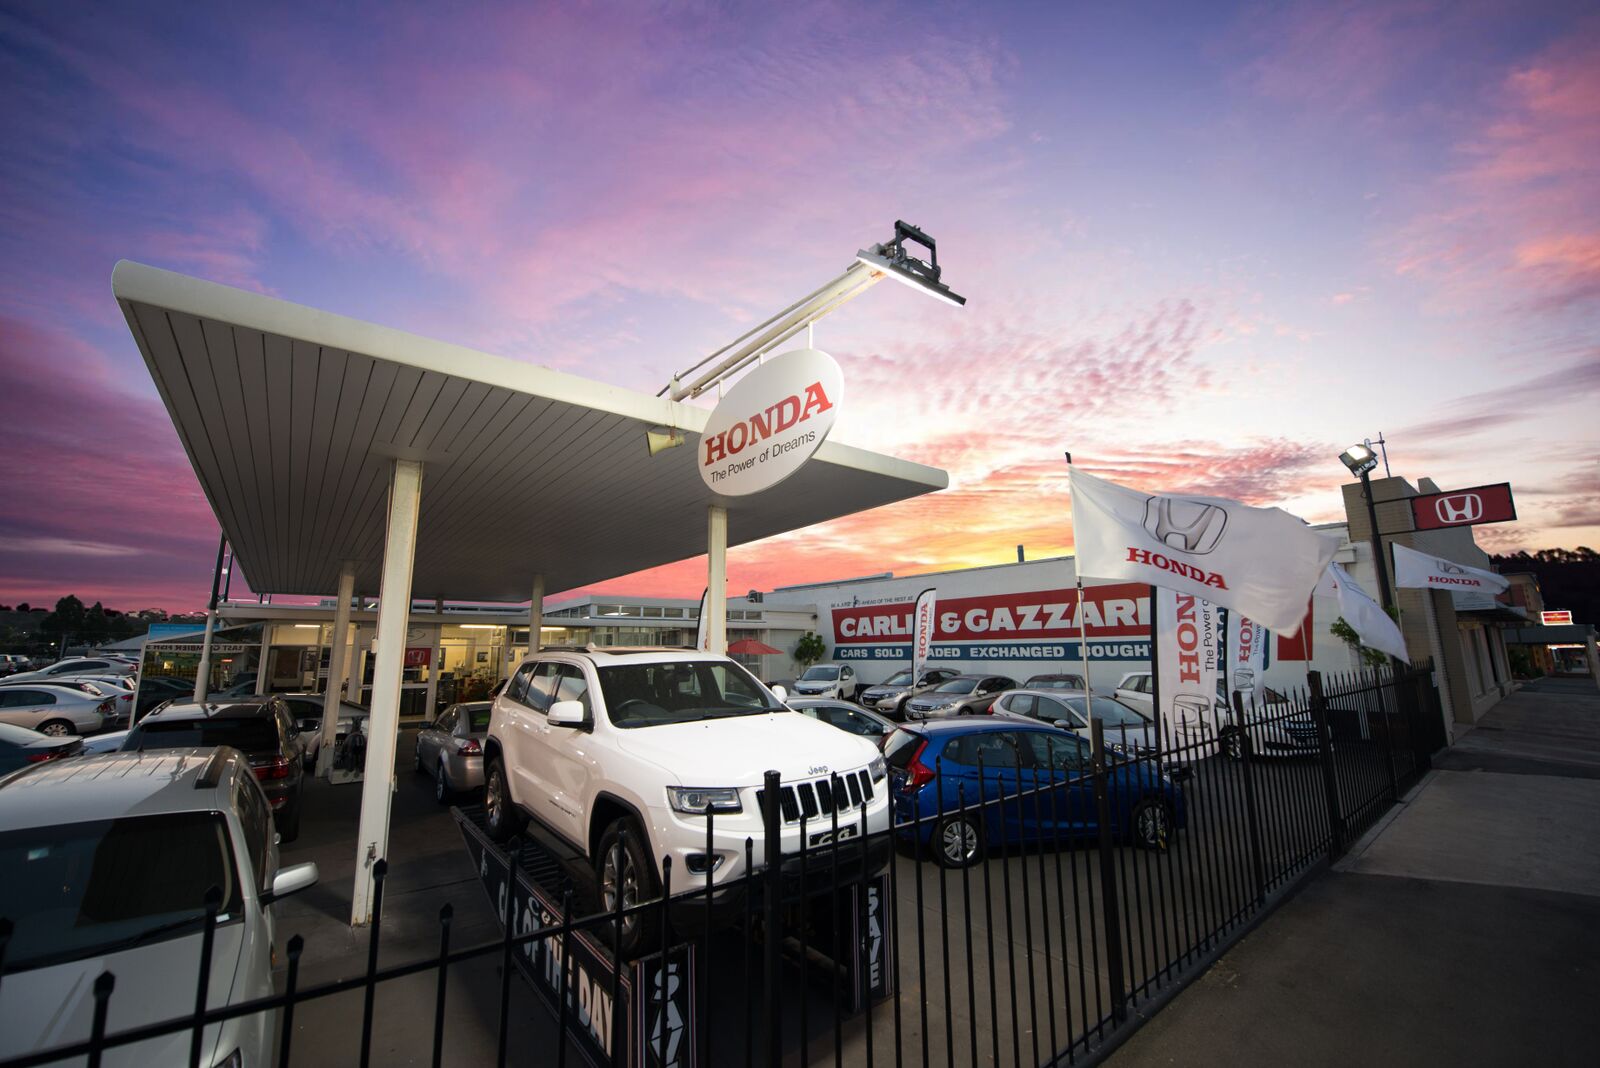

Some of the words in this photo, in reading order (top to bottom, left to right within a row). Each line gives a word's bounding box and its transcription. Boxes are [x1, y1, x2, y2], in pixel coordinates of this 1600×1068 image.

[705, 382, 833, 466] HONDA
[710, 469, 727, 483] The
[728, 456, 757, 476] Power
[759, 448, 770, 463] of
[772, 430, 816, 457] Dreams
[1126, 547, 1229, 590] HONDA
[1428, 576, 1481, 587] HONDA
[840, 613, 935, 637] CARLI
[940, 612, 962, 633] &
[918, 603, 929, 658] HONDA
[1176, 592, 1200, 684] HON
[1203, 609, 1213, 647] Power
[1239, 616, 1253, 662] HON
[840, 648, 868, 658] CARS
[875, 648, 904, 657] SOLD
[927, 647, 961, 657] ADED
[970, 646, 1065, 658] EXCHANGED
[1077, 644, 1152, 657] BOUGH
[1205, 651, 1215, 673] The
[808, 765, 829, 776] Jeep
[578, 963, 614, 1058] DAY
